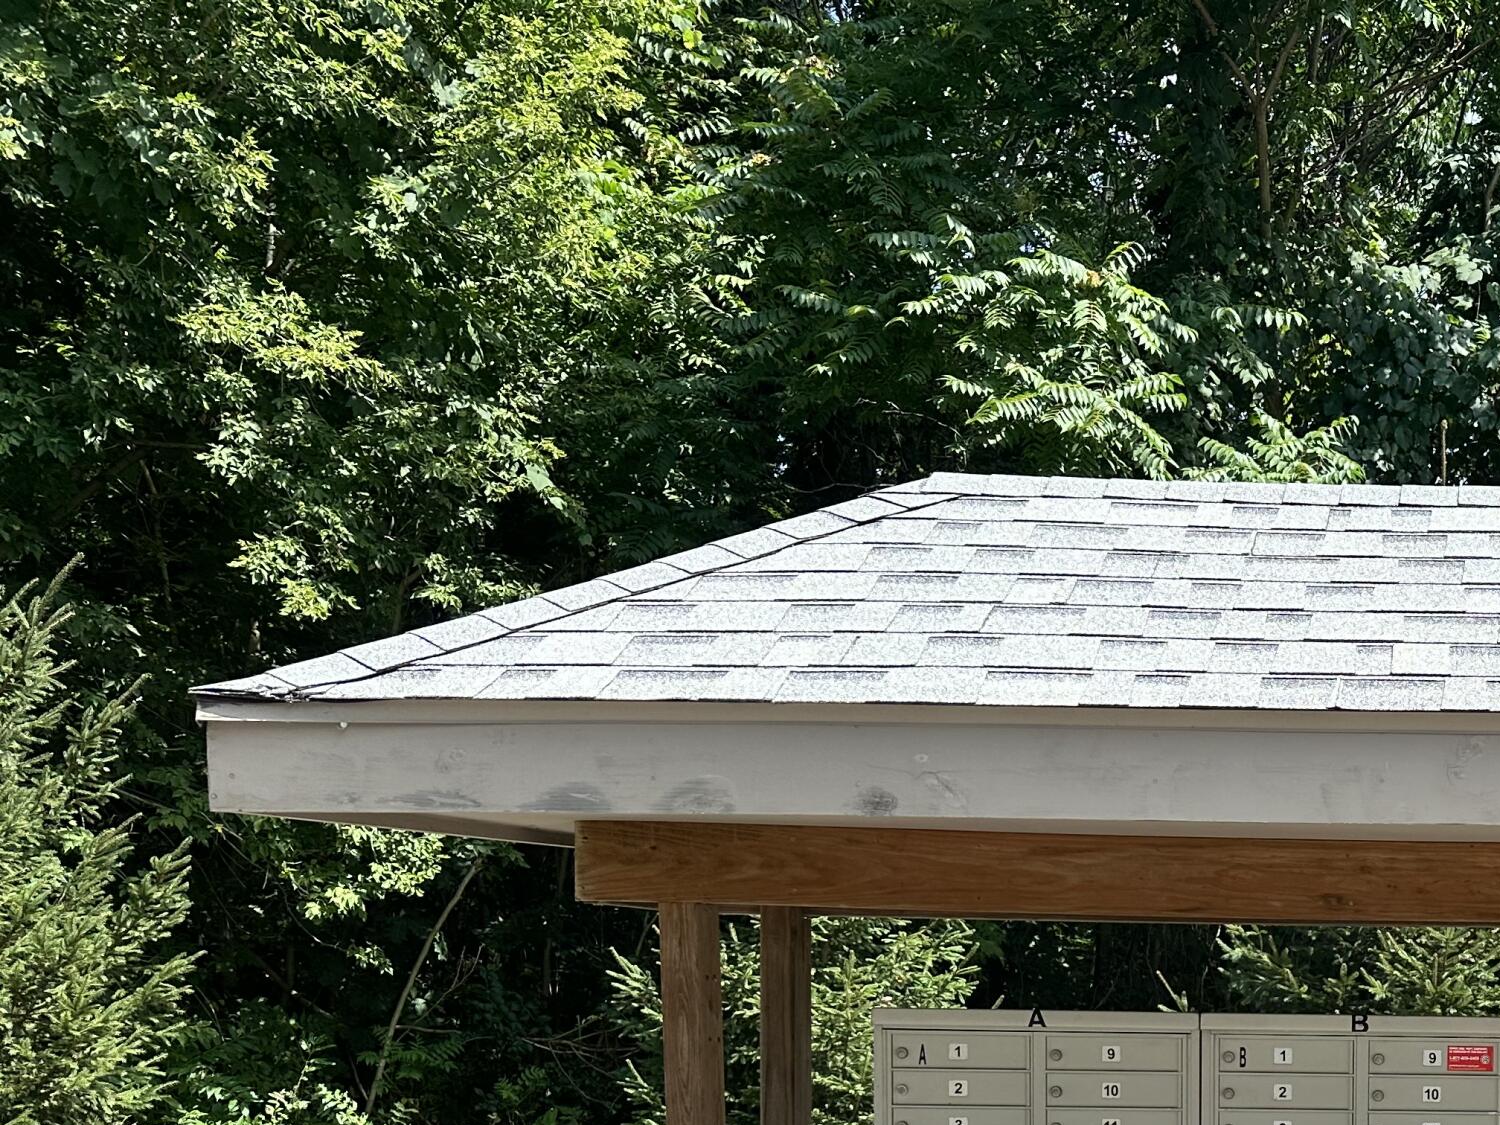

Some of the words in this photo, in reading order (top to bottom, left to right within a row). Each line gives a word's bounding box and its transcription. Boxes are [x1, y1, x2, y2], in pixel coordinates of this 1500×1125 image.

[1028, 1007, 1046, 1028] A
[1351, 1014, 1369, 1033] B
[918, 1043, 927, 1065] A
[954, 1045, 961, 1058] 1
[1107, 1047, 1116, 1060] 9
[1239, 1046, 1247, 1068] B
[1279, 1049, 1286, 1062] 1
[1428, 1052, 1437, 1064] 9
[954, 1082, 963, 1095] 2
[1103, 1084, 1119, 1097] 10
[1278, 1086, 1287, 1099] 2
[1424, 1088, 1440, 1101] 10
